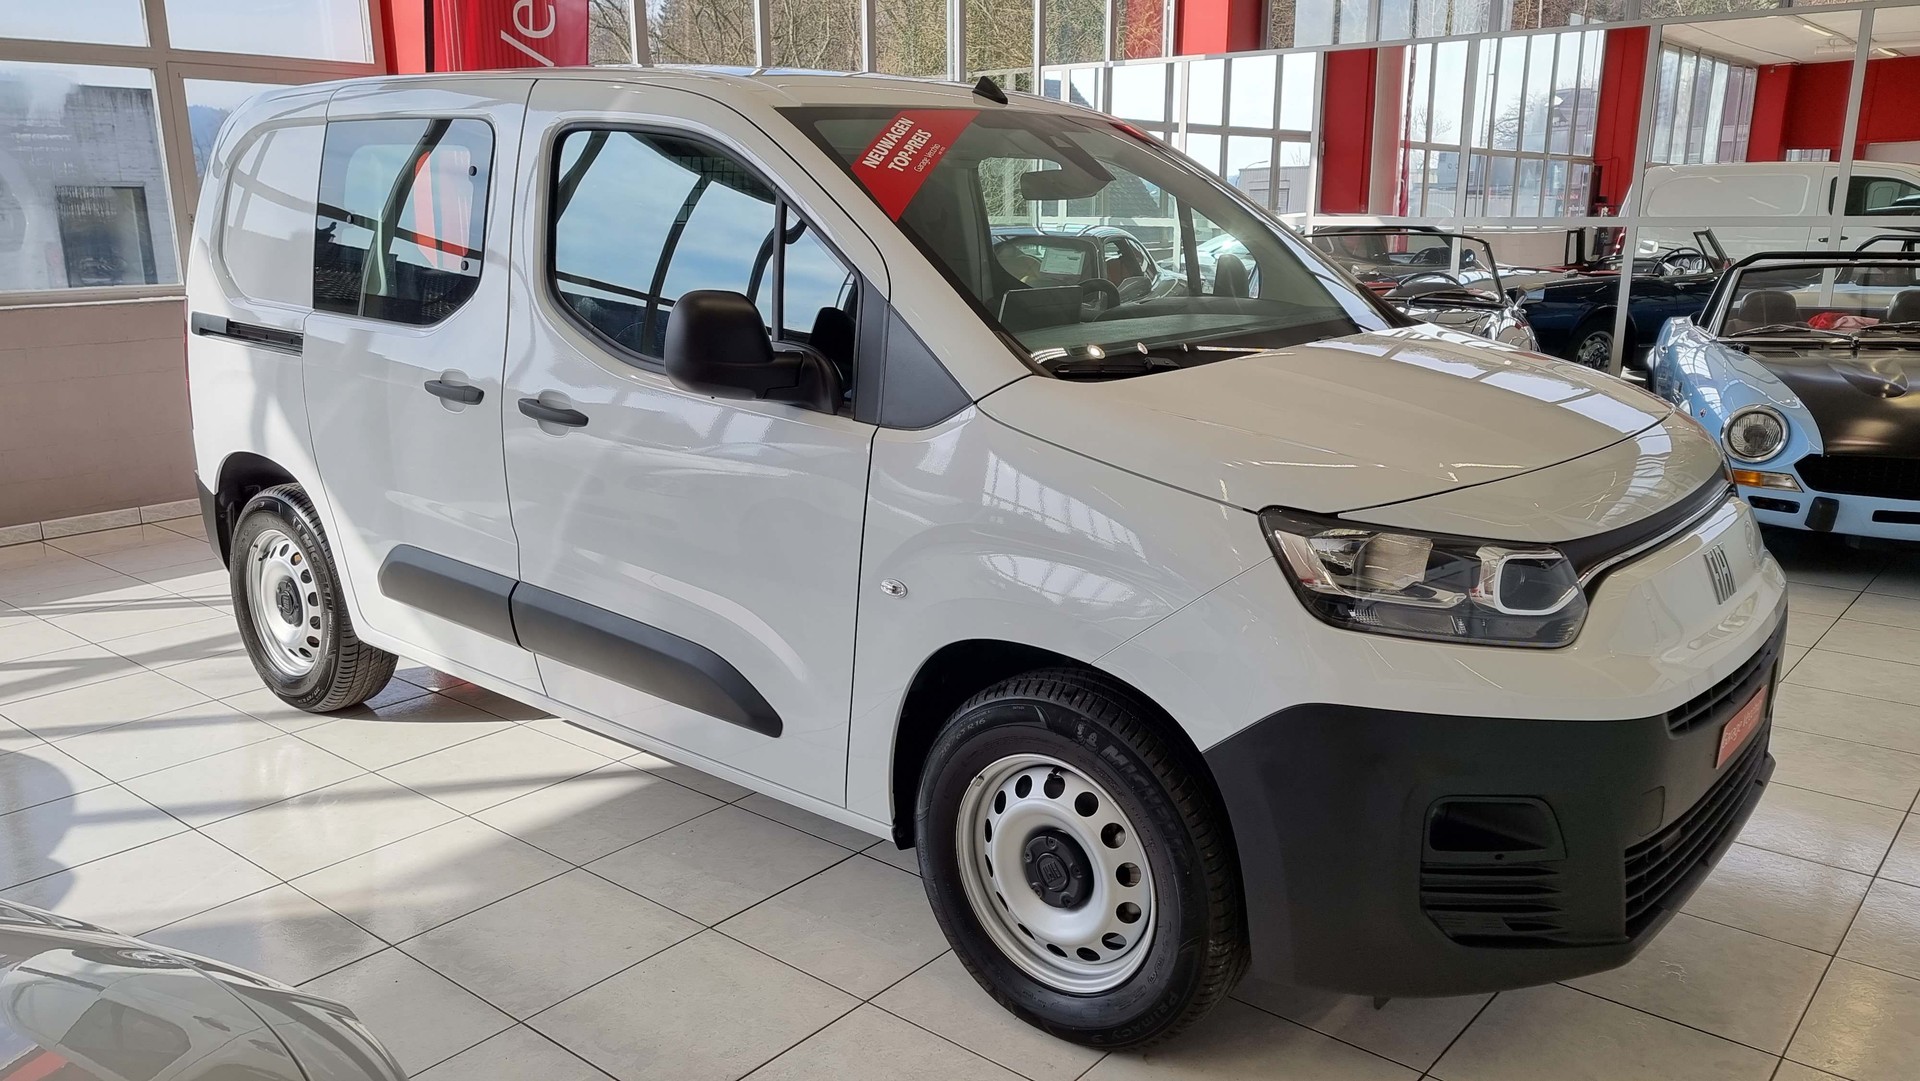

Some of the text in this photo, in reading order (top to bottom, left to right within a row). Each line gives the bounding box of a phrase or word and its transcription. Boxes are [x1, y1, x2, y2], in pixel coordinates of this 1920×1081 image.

[862, 117, 915, 169] NEUWAGEN
[887, 128, 932, 172] TOP-PREIS
[913, 156, 931, 173] Garage
